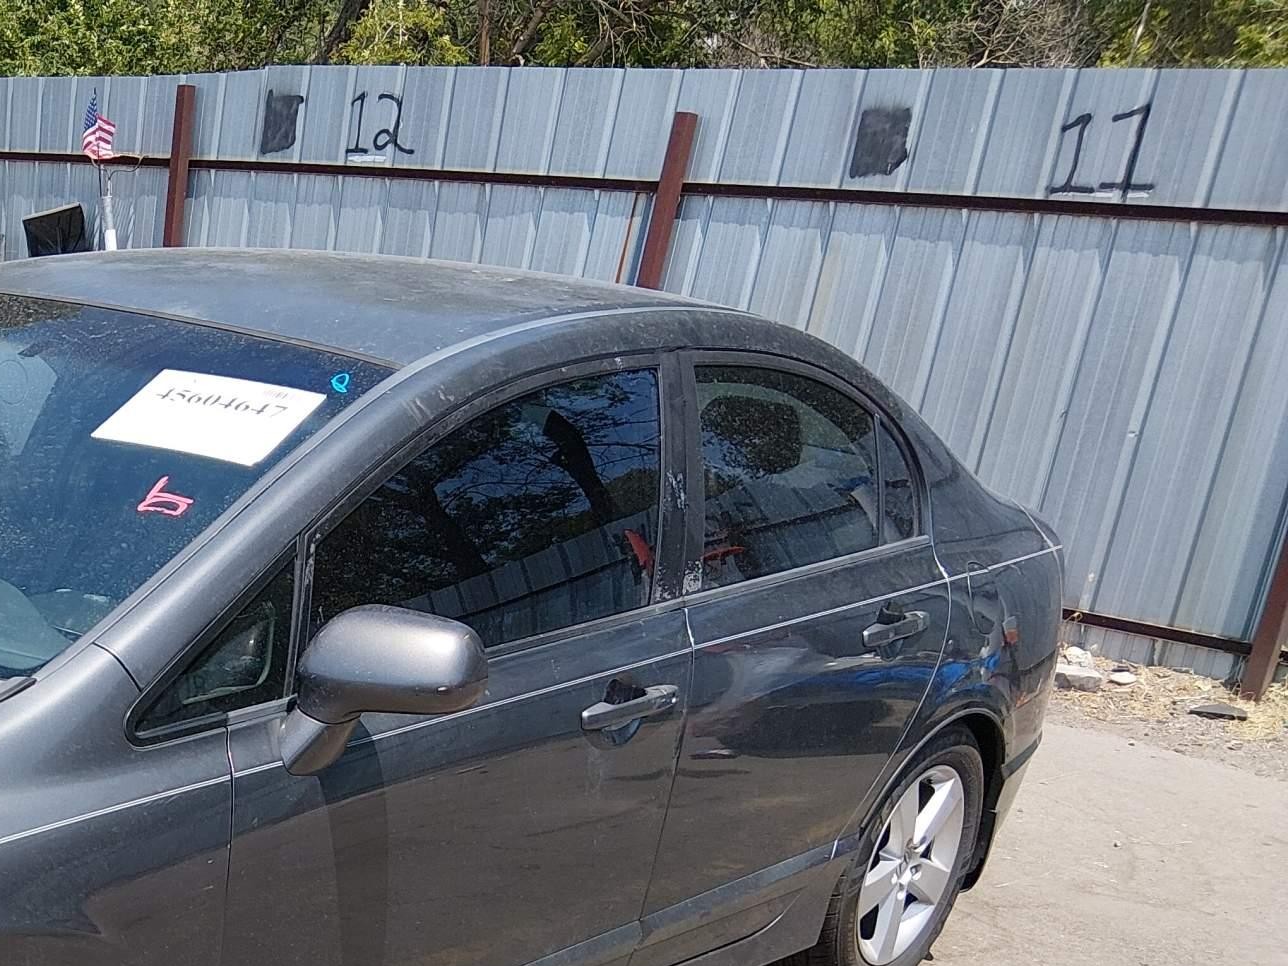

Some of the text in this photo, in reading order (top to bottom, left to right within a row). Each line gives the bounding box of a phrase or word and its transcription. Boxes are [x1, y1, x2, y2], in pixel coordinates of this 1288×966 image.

[345, 91, 415, 155] 12
[1045, 103, 1155, 196] 11
[156, 387, 289, 418] 45604647
